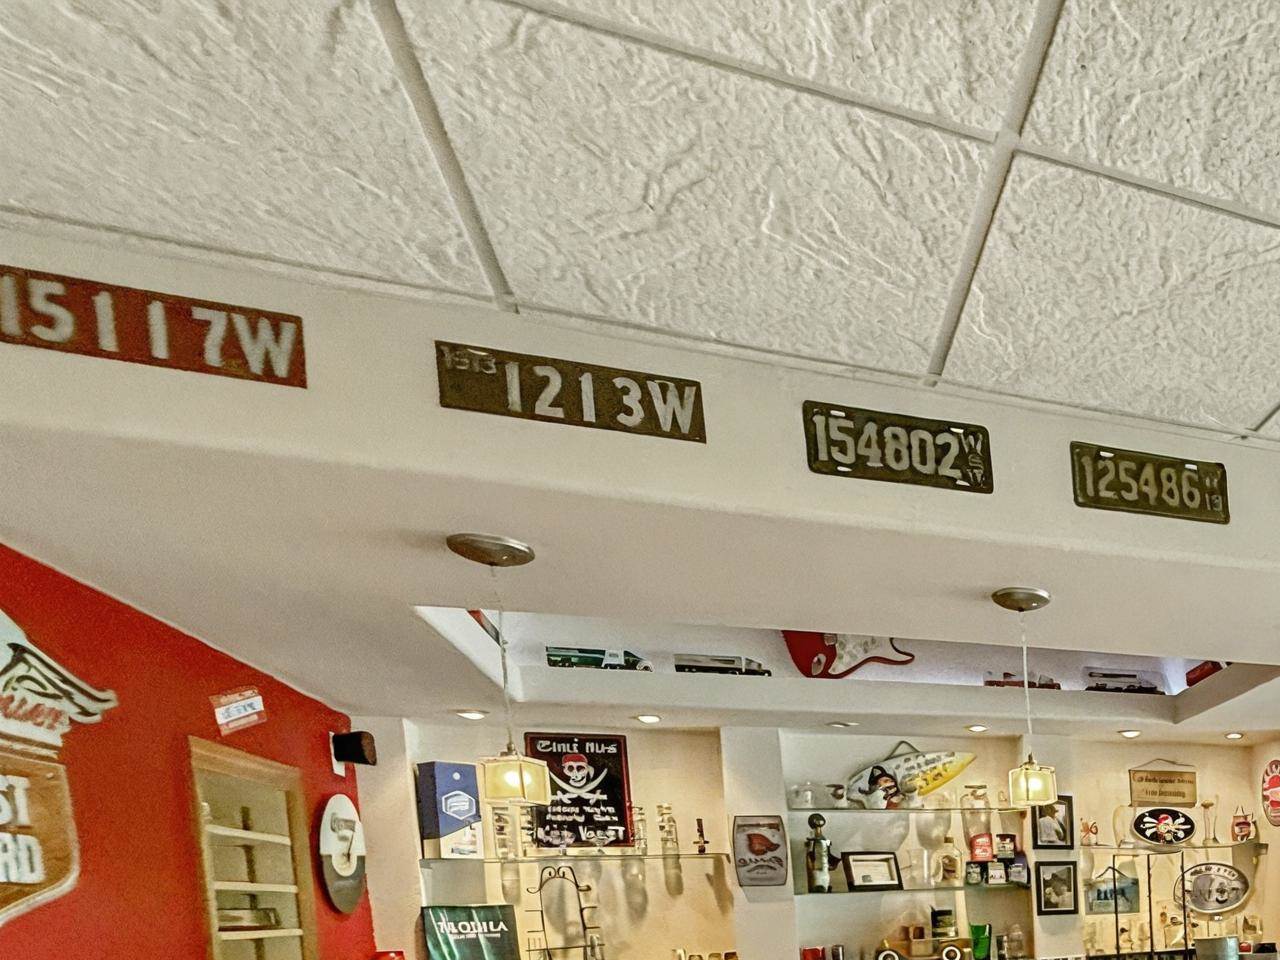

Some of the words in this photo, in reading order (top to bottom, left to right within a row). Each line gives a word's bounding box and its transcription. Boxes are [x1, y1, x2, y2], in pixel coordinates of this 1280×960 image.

[505, 360, 697, 434] 1213W
[812, 413, 963, 480] 154802
[1080, 455, 1201, 509] 125486
